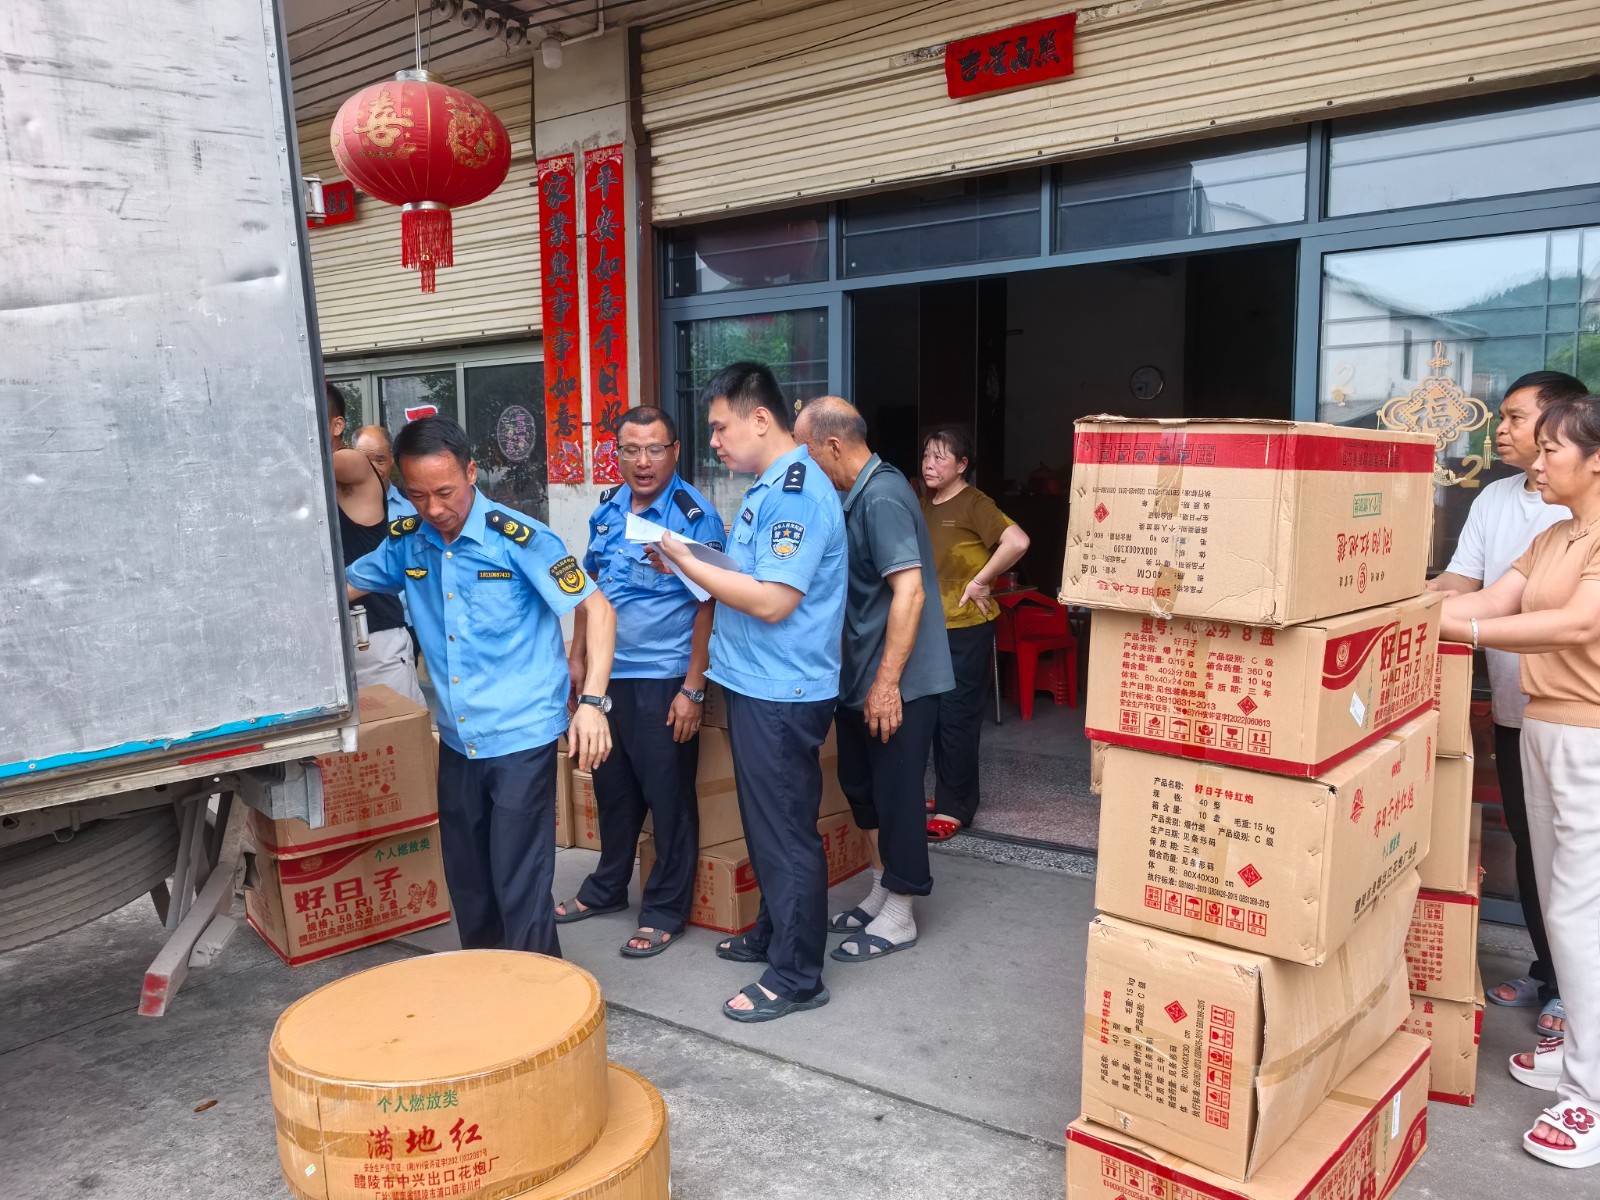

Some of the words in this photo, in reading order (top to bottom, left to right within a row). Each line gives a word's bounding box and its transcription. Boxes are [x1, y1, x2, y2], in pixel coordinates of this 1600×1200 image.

[1336, 527, 1393, 562] 浏阳红地毯
[1137, 569, 1162, 578] 40CM
[1124, 632, 1158, 642] 产品名称:
[1174, 637, 1197, 647] 好日子
[1242, 627, 1252, 641] 8
[1124, 642, 1157, 653] 产品类别:
[1380, 622, 1427, 672] 好日子
[1123, 652, 1164, 663] 单个含药量:
[1208, 652, 1244, 663] 产品级别:
[1122, 662, 1148, 671] 箱含量:
[1206, 662, 1243, 673] 箱含药量:
[1247, 667, 1263, 675] 360
[1267, 669, 1272, 677] g
[1381, 667, 1401, 688] HAO
[1404, 662, 1412, 678] RI
[1414, 658, 1421, 673] ZI
[1121, 671, 1139, 680] 体积:
[1262, 679, 1271, 688] kg
[1121, 680, 1154, 692] 生产日期:
[1156, 685, 1206, 699] 见包装条形码
[1121, 690, 1153, 702] 执行标准:
[1154, 777, 1183, 790] 产品名称:
[1195, 783, 1254, 804] 好日子特红炮
[1199, 799, 1208, 807] 40
[1151, 814, 1180, 826] 产品类别:
[1218, 827, 1250, 842] 产品级别:
[1234, 819, 1251, 829] 毛重:
[1254, 822, 1262, 830] 15
[1266, 824, 1275, 834] kg
[1150, 826, 1180, 839] 生产日期:
[1183, 832, 1216, 847] 见条形码
[1183, 845, 1199, 855] 三年
[1149, 849, 1178, 863] 箱含药量:
[1182, 857, 1214, 871] 见条形码
[1147, 872, 1177, 886] 执行标准:
[1183, 870, 1218, 884] 80X40X30
[295, 867, 402, 913] 好日子
[305, 904, 348, 922] HAO
[356, 897, 372, 909] RI
[380, 889, 397, 901] ZI
[339, 913, 352, 923] 50
[355, 907, 374, 919] 公分
[1127, 978, 1135, 986] kg
[1101, 990, 1111, 1044] 好日子特红炮
[1135, 1003, 1144, 1033] 产品级别:
[1112, 1035, 1119, 1043] 40
[1124, 1039, 1131, 1047] 10
[1101, 1054, 1109, 1083] 产品名称:
[1157, 1056, 1165, 1072] 三年
[1134, 1067, 1142, 1096] 产品类别:
[378, 1090, 458, 1113] 个人燃放类
[1168, 1080, 1177, 1108] 箱含药量:
[1192, 1088, 1201, 1117] 执行标准:
[367, 1117, 483, 1161] 满地红
[354, 1156, 499, 1189] 醴陵市中兴出口花炮厂
